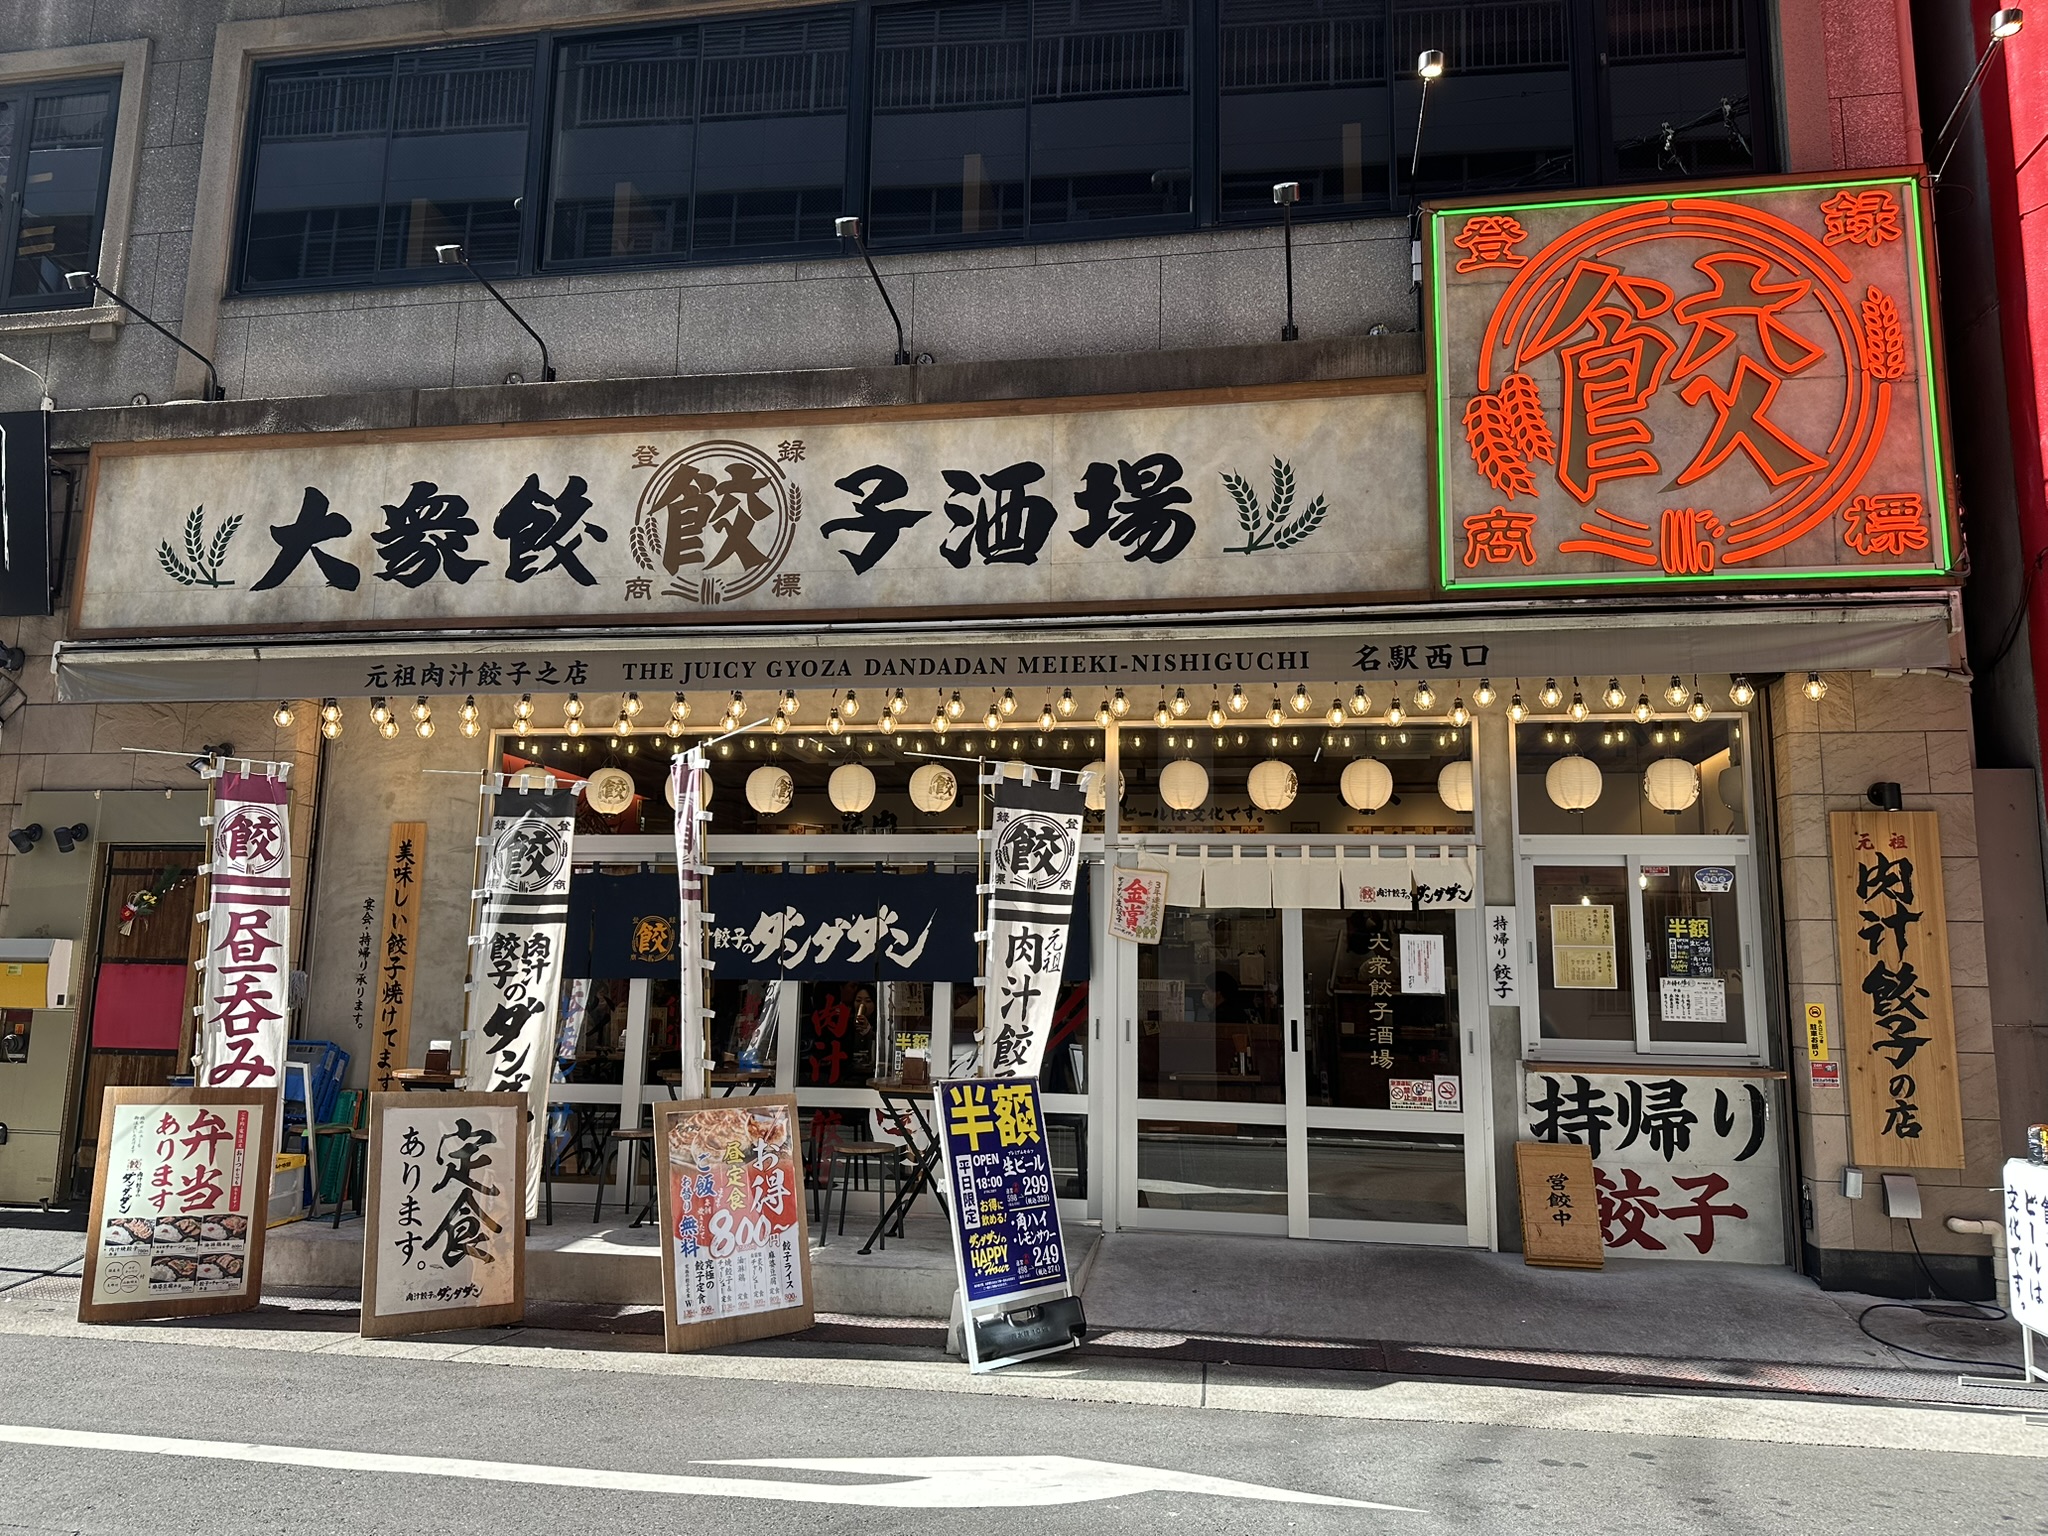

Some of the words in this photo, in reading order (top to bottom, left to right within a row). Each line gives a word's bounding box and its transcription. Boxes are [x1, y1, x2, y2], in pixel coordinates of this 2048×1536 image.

[1455, 215, 1528, 274] 登
[1820, 190, 1902, 248] 録
[1521, 252, 1829, 505] 餃
[632, 444, 661, 469] 登
[778, 439, 805, 464] 録
[250, 474, 607, 592] 大衆餃
[820, 453, 1197, 575] 子酒場
[649, 461, 774, 577] 餃
[1463, 505, 1538, 569] 商
[1844, 493, 1930, 555] 標
[625, 579, 652, 602] 商
[772, 574, 802, 598] 標
[365, 660, 589, 690] 元祖肉汁餃子之店
[622, 661, 674, 684] THE
[682, 658, 756, 684] JUICY
[765, 657, 852, 680] GYOZA
[864, 656, 1007, 679] DANDADAN
[1017, 650, 1310, 675] MEIEKI-NISHIGUCHI
[1352, 644, 1491, 673] 名駅西口
[222, 814, 280, 862] 餃
[500, 829, 555, 880] 餃
[1004, 822, 1063, 877] 餃
[1855, 833, 1909, 852] 元祖
[1121, 878, 1148, 932] 金賞
[1376, 882, 1473, 904] 肉汁餃子のダンダダン
[637, 922, 668, 954] 餃
[1042, 928, 1064, 974] 元祖
[1668, 918, 1710, 938] 半額
[352, 897, 375, 1029] 宴会・持帰り承ります。
[377, 839, 416, 1092] 美味しい餃子焼けてます
[523, 932, 551, 985] 肉汁
[1493, 915, 1514, 999] 持帰り餃子
[208, 909, 283, 1088] 昼呑み
[992, 926, 1045, 1079] 肉汁餃
[1366, 933, 1395, 1070] 大衆餃子酒場
[1856, 851, 1932, 1139] 肉汁餃子の店
[950, 1084, 1041, 1151] 半額
[1528, 1075, 1766, 1162] 持帰り
[148, 1111, 181, 1214] あります
[176, 1108, 234, 1214] 弁当
[694, 1152, 717, 1199] ご飯
[724, 1140, 746, 1211] 昼定食
[750, 1137, 791, 1215] お得
[973, 1153, 1000, 1167] OPEN
[976, 1175, 1003, 1190] 18:00
[1002, 1154, 1045, 1177] 生ビール
[1023, 1174, 1049, 1196] 299
[394, 1126, 428, 1272] あります。
[423, 1117, 502, 1268] 定食
[681, 1174, 692, 1215] お替り
[958, 1160, 978, 1226] 平日限定
[980, 1198, 1004, 1212] お得に
[1546, 1172, 1574, 1227] 営餃中
[1591, 1167, 1748, 1255] 餃子
[679, 1215, 700, 1259] 無料
[971, 1244, 1008, 1269] HAPPY
[1032, 1243, 1059, 1267] 249
[2007, 1184, 2026, 1311] 文化です。
[2024, 1190, 2044, 1305] ビールは
[695, 1260, 706, 1305] 餃子定食
[704, 1259, 715, 1290] 究極の
[782, 1240, 794, 1289] 餃子ライス
[983, 1261, 1010, 1277] Hour
[405, 1282, 484, 1302] 肉汁餃子のダンダダン
